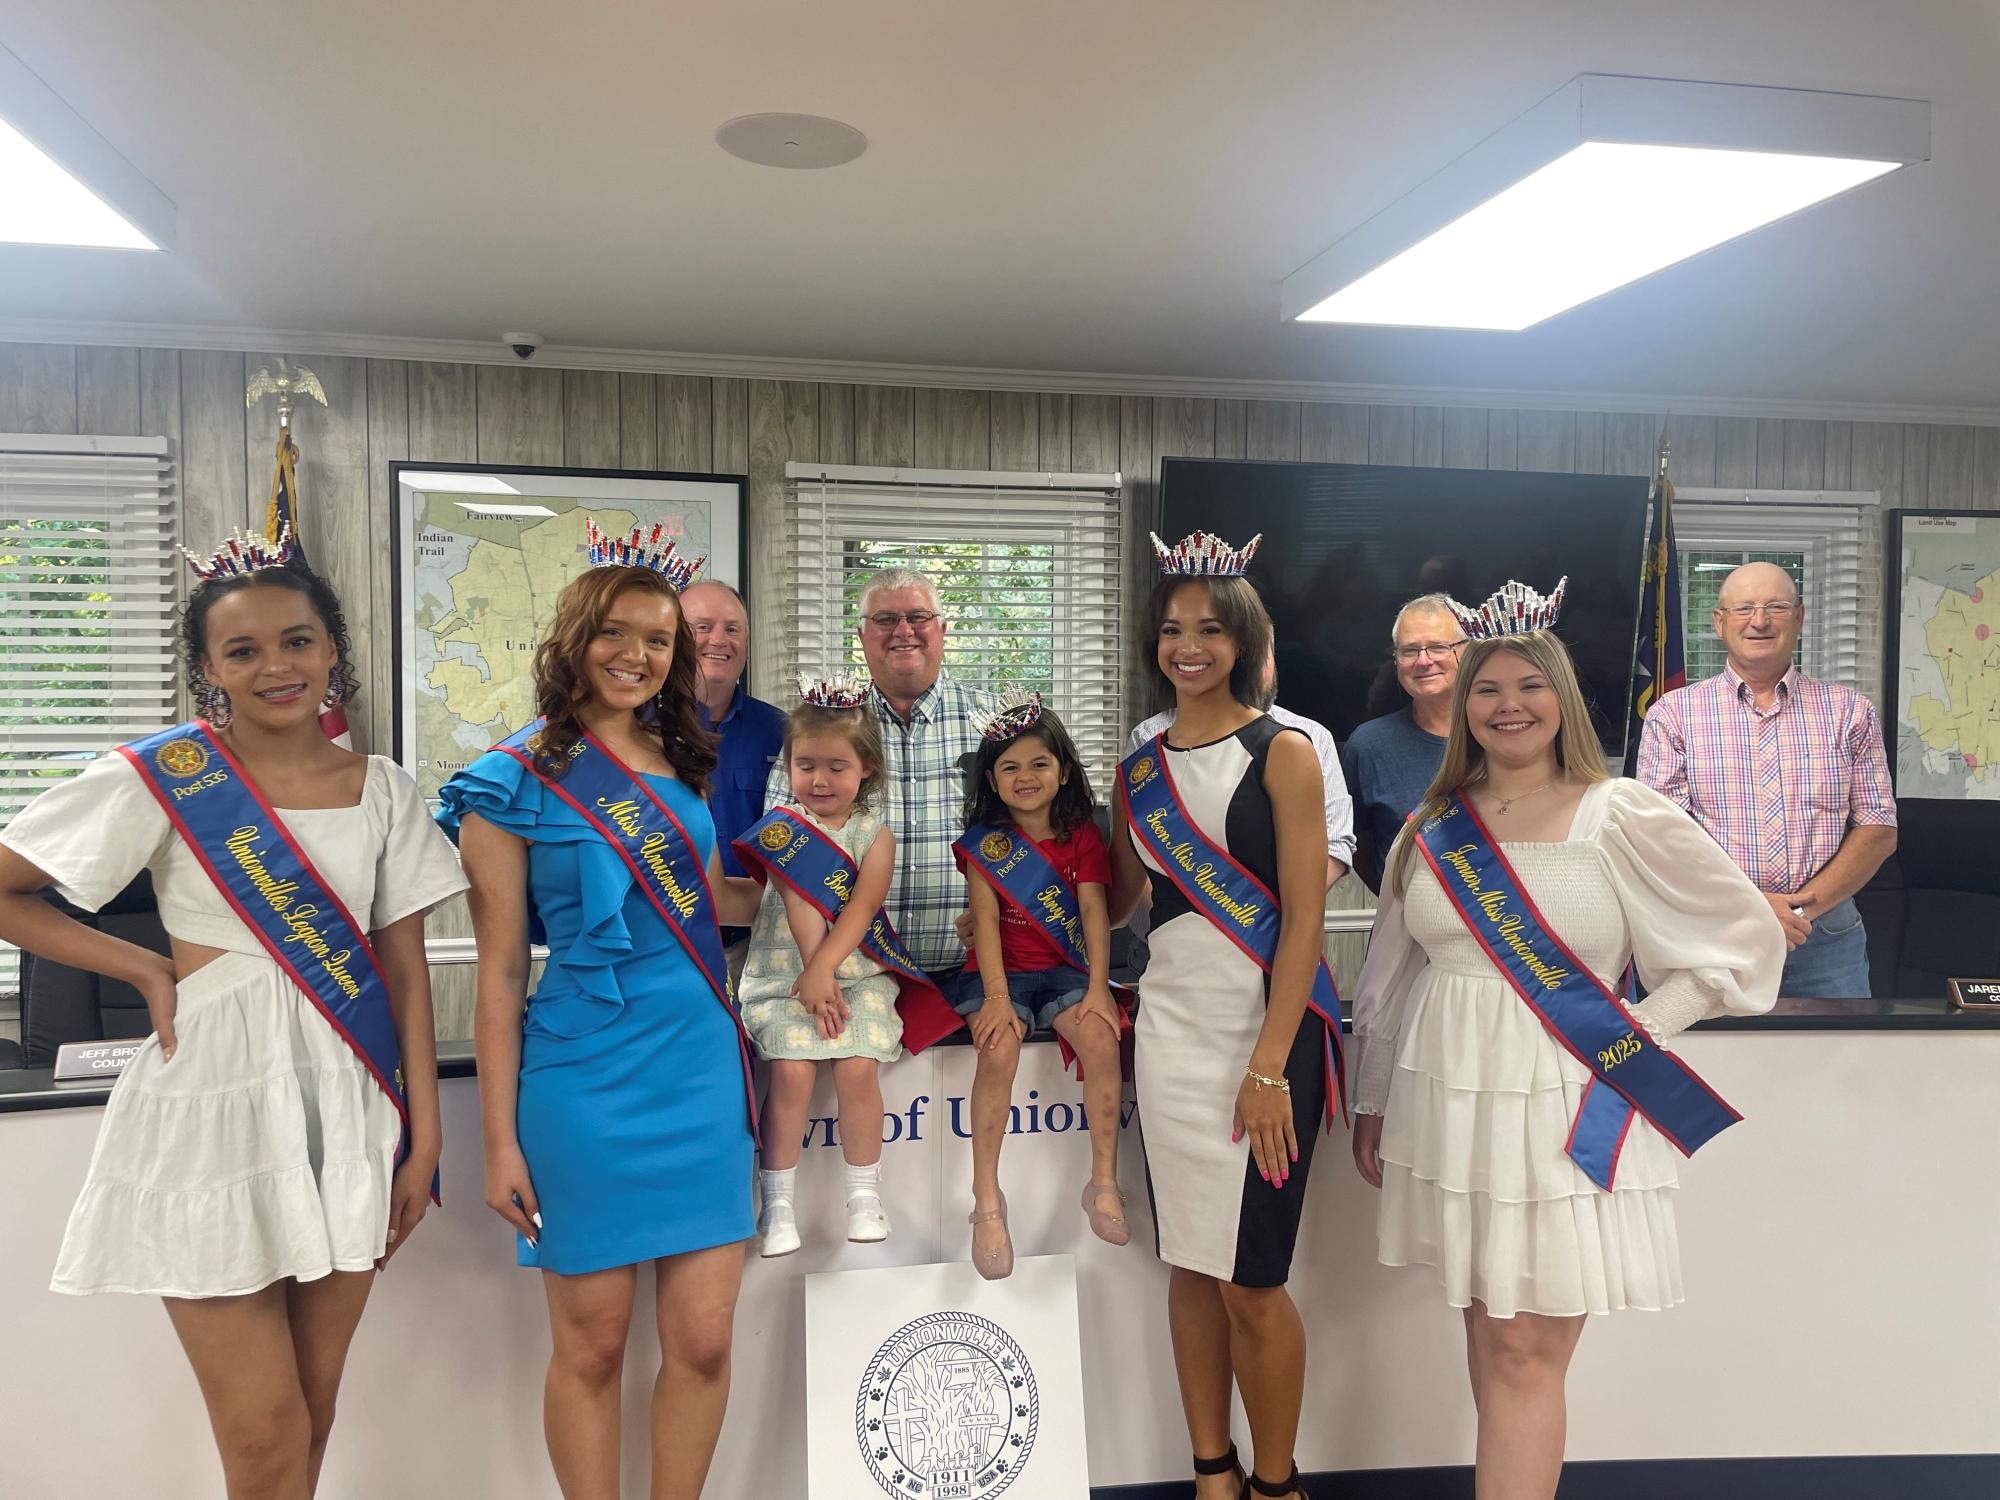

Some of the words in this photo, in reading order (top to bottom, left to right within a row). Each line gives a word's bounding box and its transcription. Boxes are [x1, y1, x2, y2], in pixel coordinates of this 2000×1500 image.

[466, 511, 513, 521] Fairview
[418, 533, 454, 543] Indian
[418, 546, 445, 556] Trail
[171, 780, 206, 801] Post
[202, 769, 229, 787] 535
[596, 797, 644, 838] Miss
[640, 832, 700, 919] Unionville
[777, 847, 797, 868] Post
[793, 833, 809, 851] 535
[996, 859, 1016, 879] Post
[1012, 847, 1029, 862] 535
[1146, 807, 1170, 844] Teen
[1166, 840, 1195, 873] Miss
[1196, 862, 1261, 929] Unionville
[1440, 844, 1482, 891] Junior
[1471, 889, 1508, 922] Miss
[1497, 914, 1569, 990] Unionville
[282, 903, 331, 959] Legion
[322, 949, 361, 1000] Queen
[1967, 984, 2000, 994] JARE
[78, 1048, 110, 1060] JEFF
[1597, 1030, 1642, 1073] 2025
[885, 1322, 1006, 1367] UNIONVILLE
[906, 1478, 923, 1493] NC
[932, 1469, 970, 1485] 1911
[977, 1469, 999, 1488] USA
[937, 1484, 967, 1498] 1998
